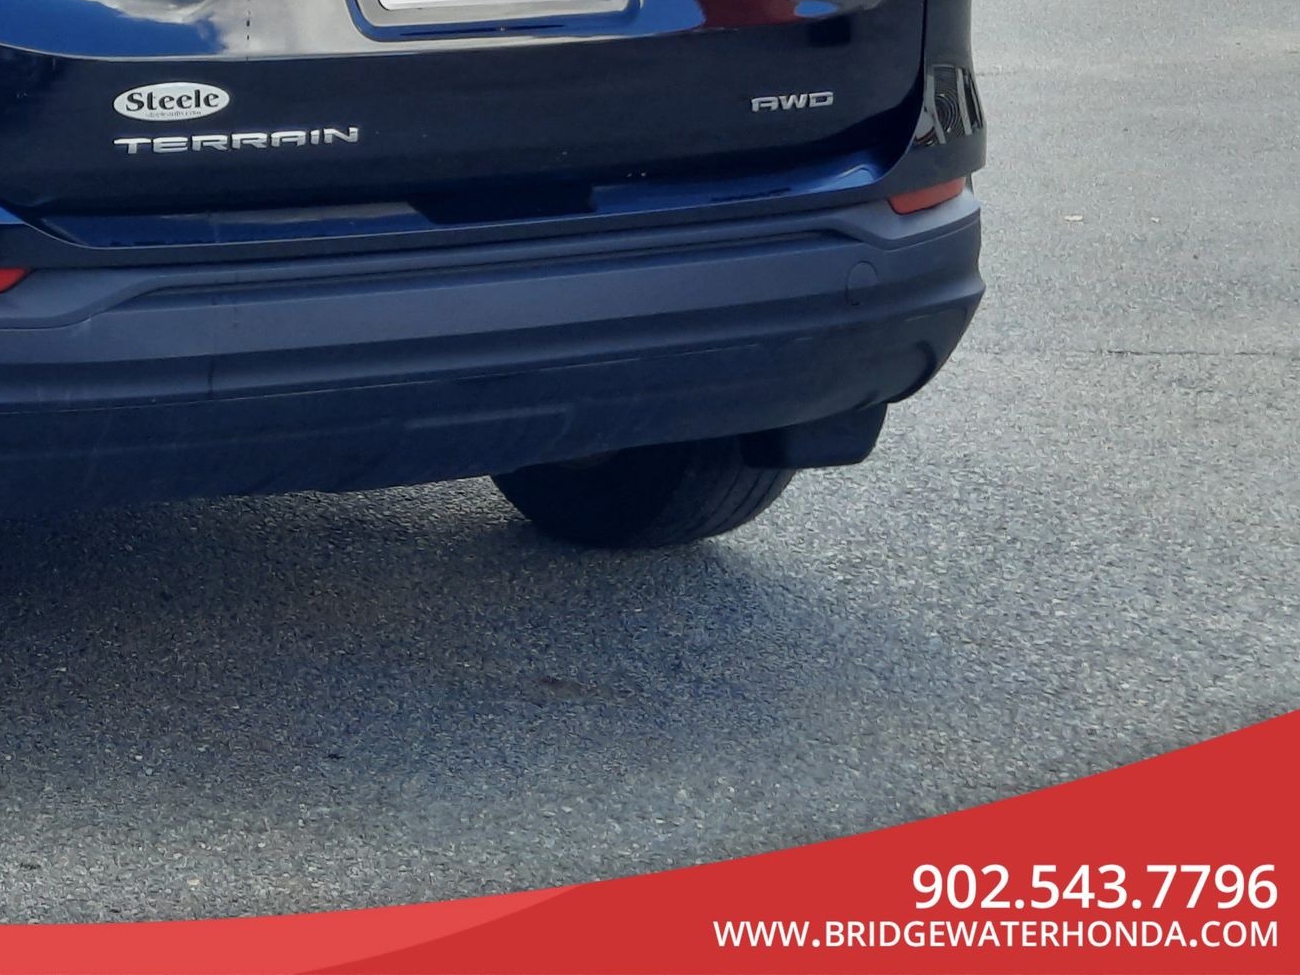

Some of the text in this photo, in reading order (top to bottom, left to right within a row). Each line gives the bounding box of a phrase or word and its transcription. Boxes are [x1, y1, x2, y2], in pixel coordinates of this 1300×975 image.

[125, 89, 220, 112] Steele
[751, 91, 834, 112] AWD
[113, 127, 360, 155] TERRAIN
